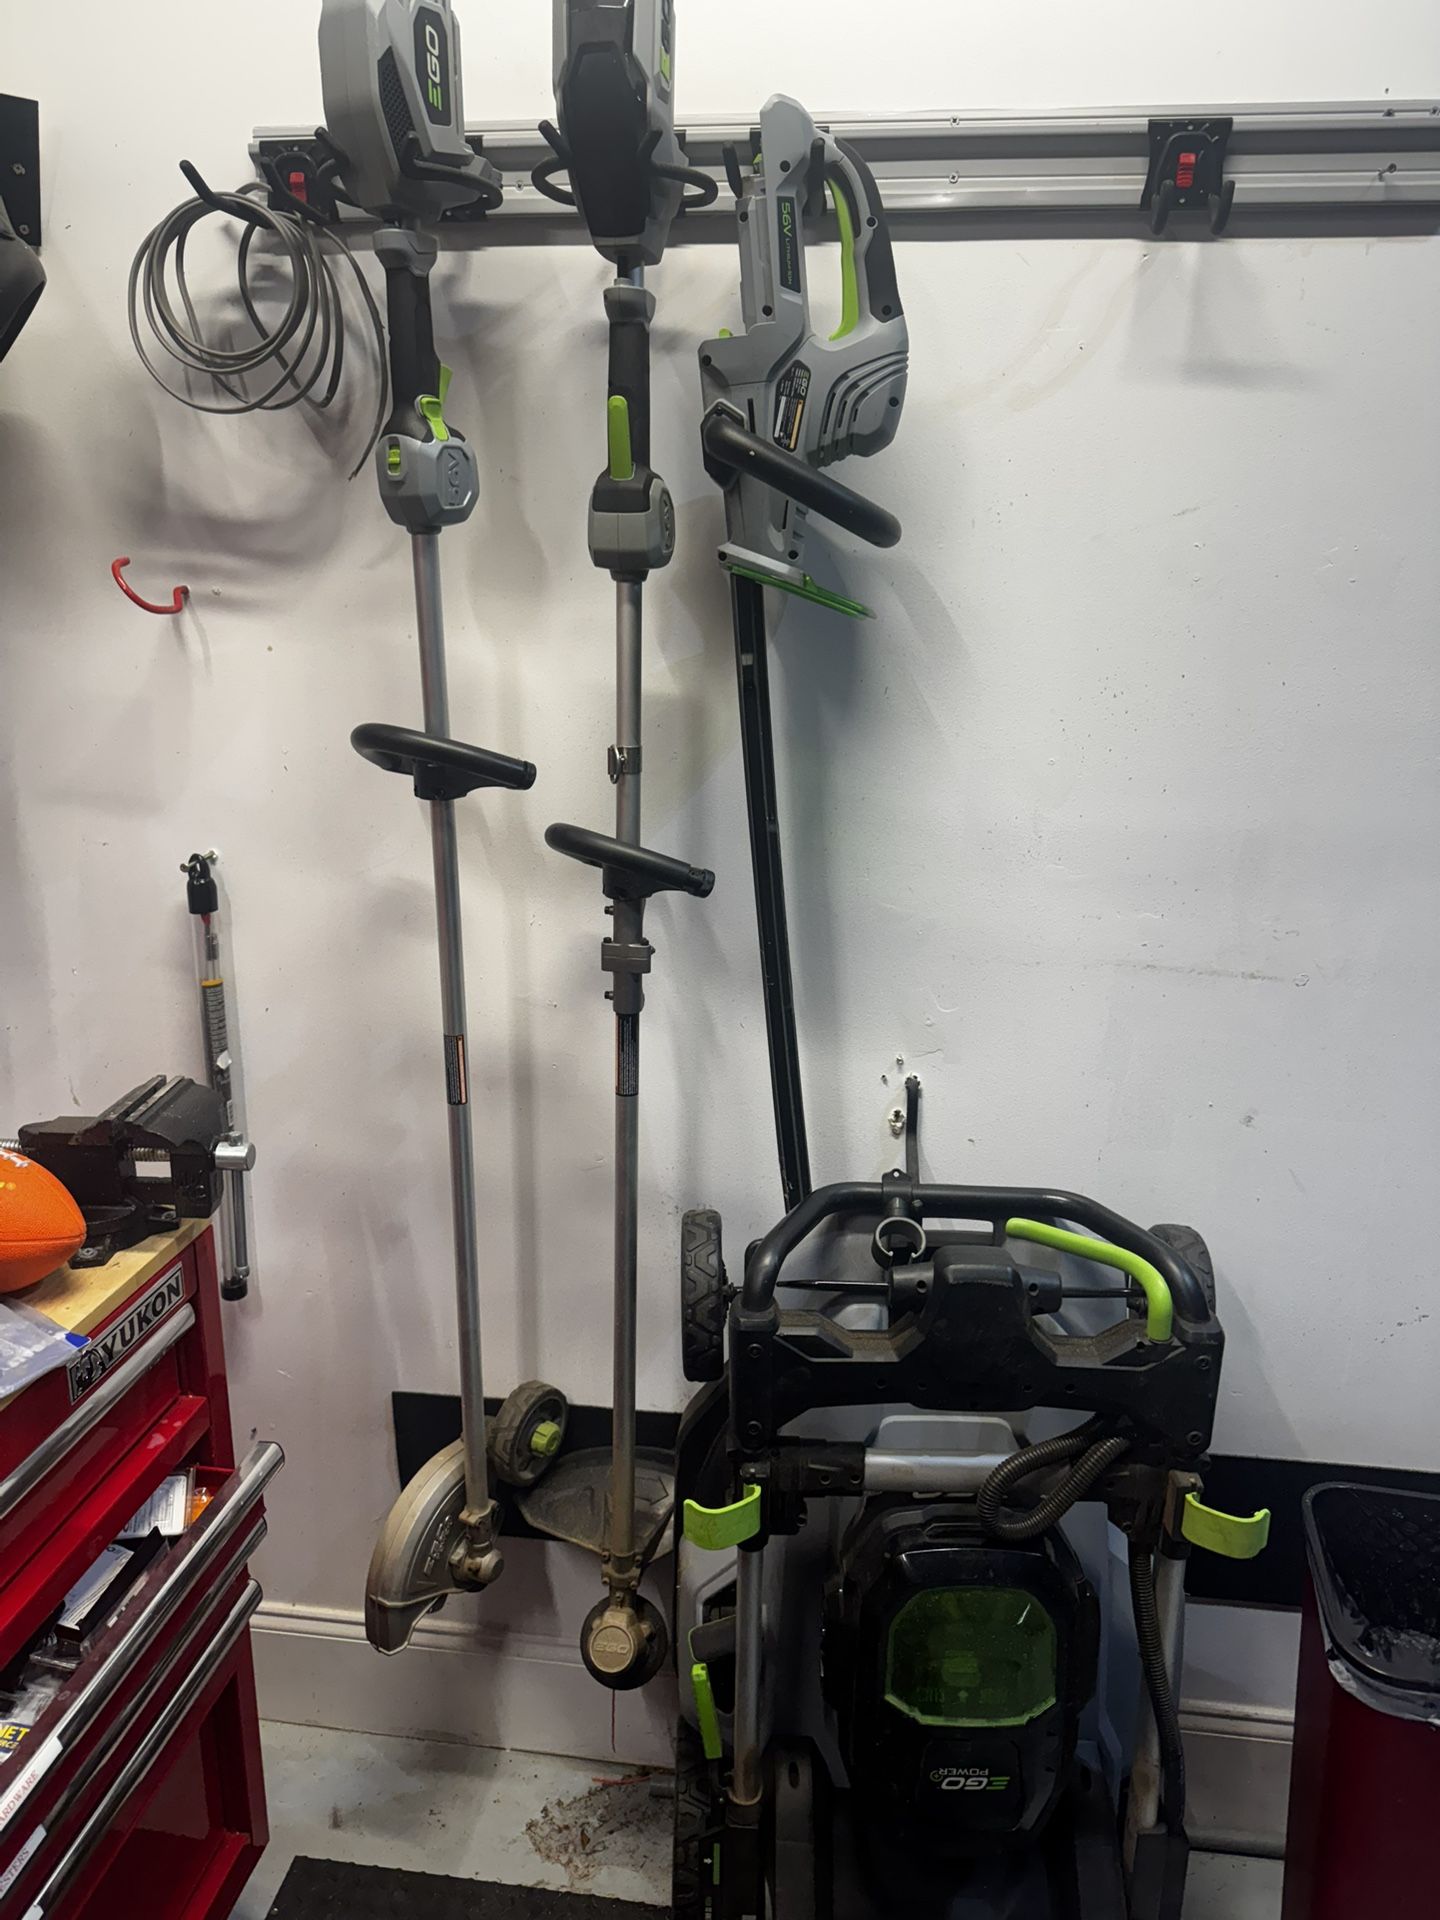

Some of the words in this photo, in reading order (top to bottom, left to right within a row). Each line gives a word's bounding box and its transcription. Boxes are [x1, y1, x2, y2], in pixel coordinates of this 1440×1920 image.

[425, 24, 442, 111] EGO
[781, 202, 793, 237] 56V
[101, 1275, 181, 1360] YUKON
[594, 1641, 630, 1655] EGO
[940, 1776, 1010, 1790] EGO
